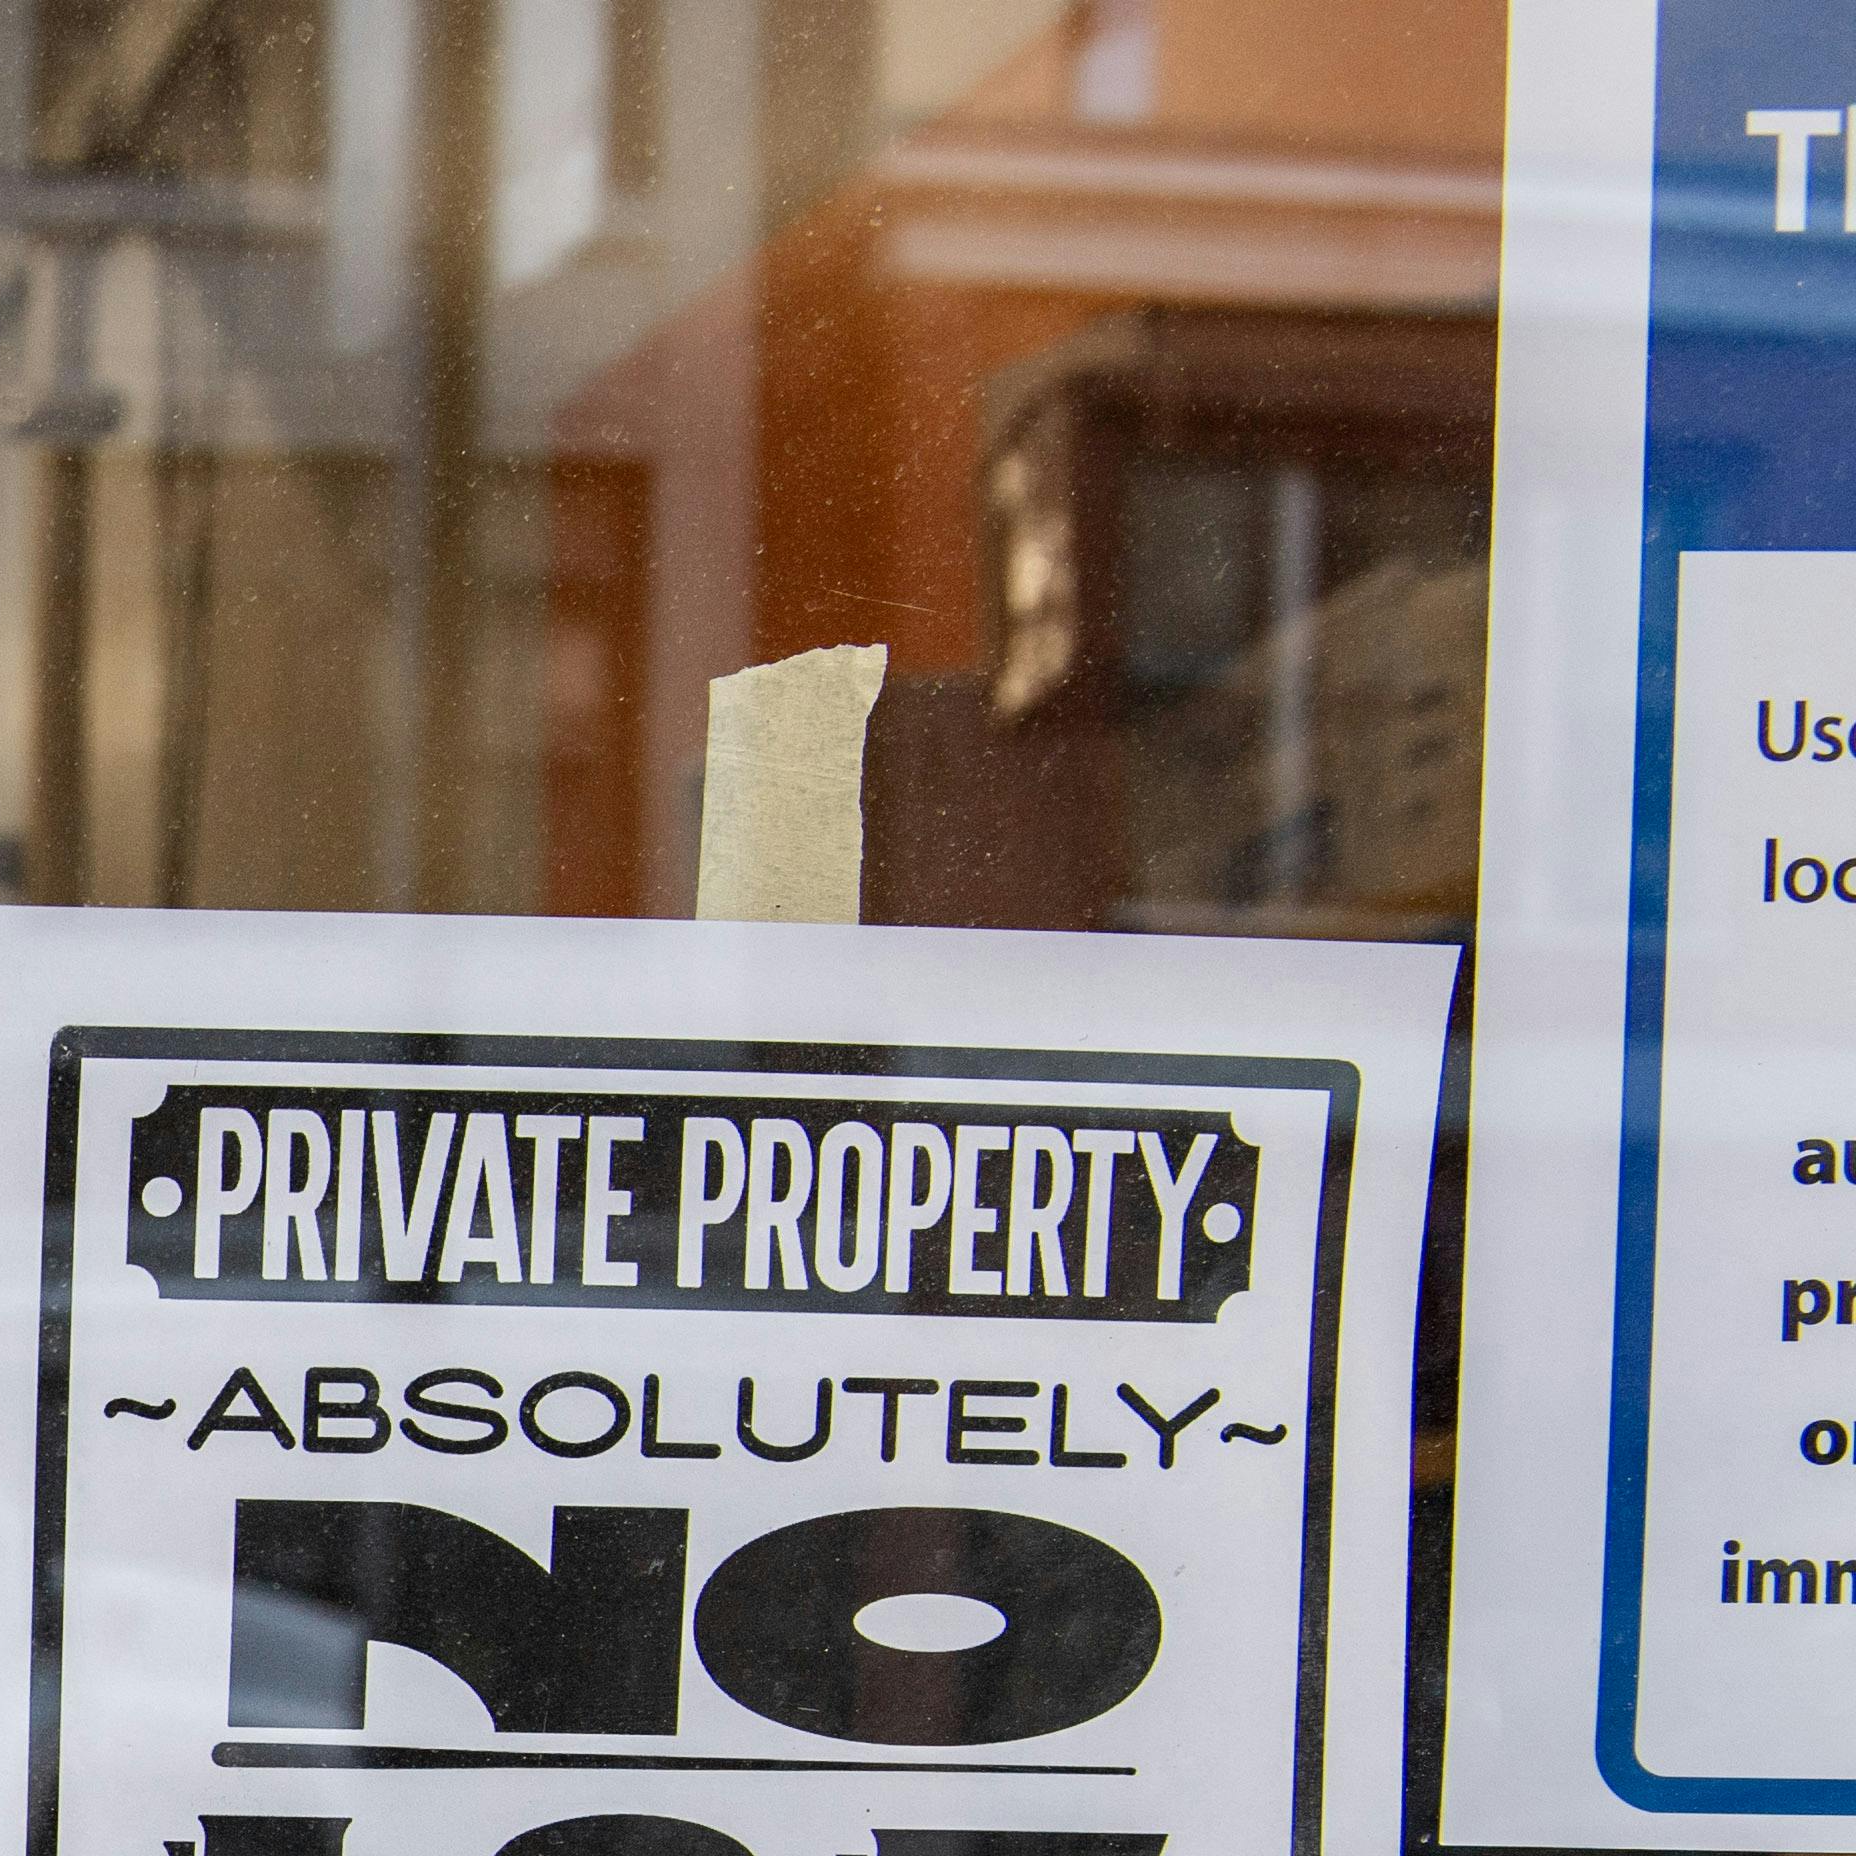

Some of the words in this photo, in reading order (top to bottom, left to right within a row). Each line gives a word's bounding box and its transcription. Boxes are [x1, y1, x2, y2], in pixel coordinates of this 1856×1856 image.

[1745, 106, 1856, 232] T
[1758, 700, 1856, 762] Us
[194, 1108, 644, 1286] PRIVATE
[677, 1117, 1221, 1300] PROPERTY
[1792, 1138, 1856, 1186] a
[1799, 1419, 1856, 1466] o
[230, 1499, 1161, 1746] NO
